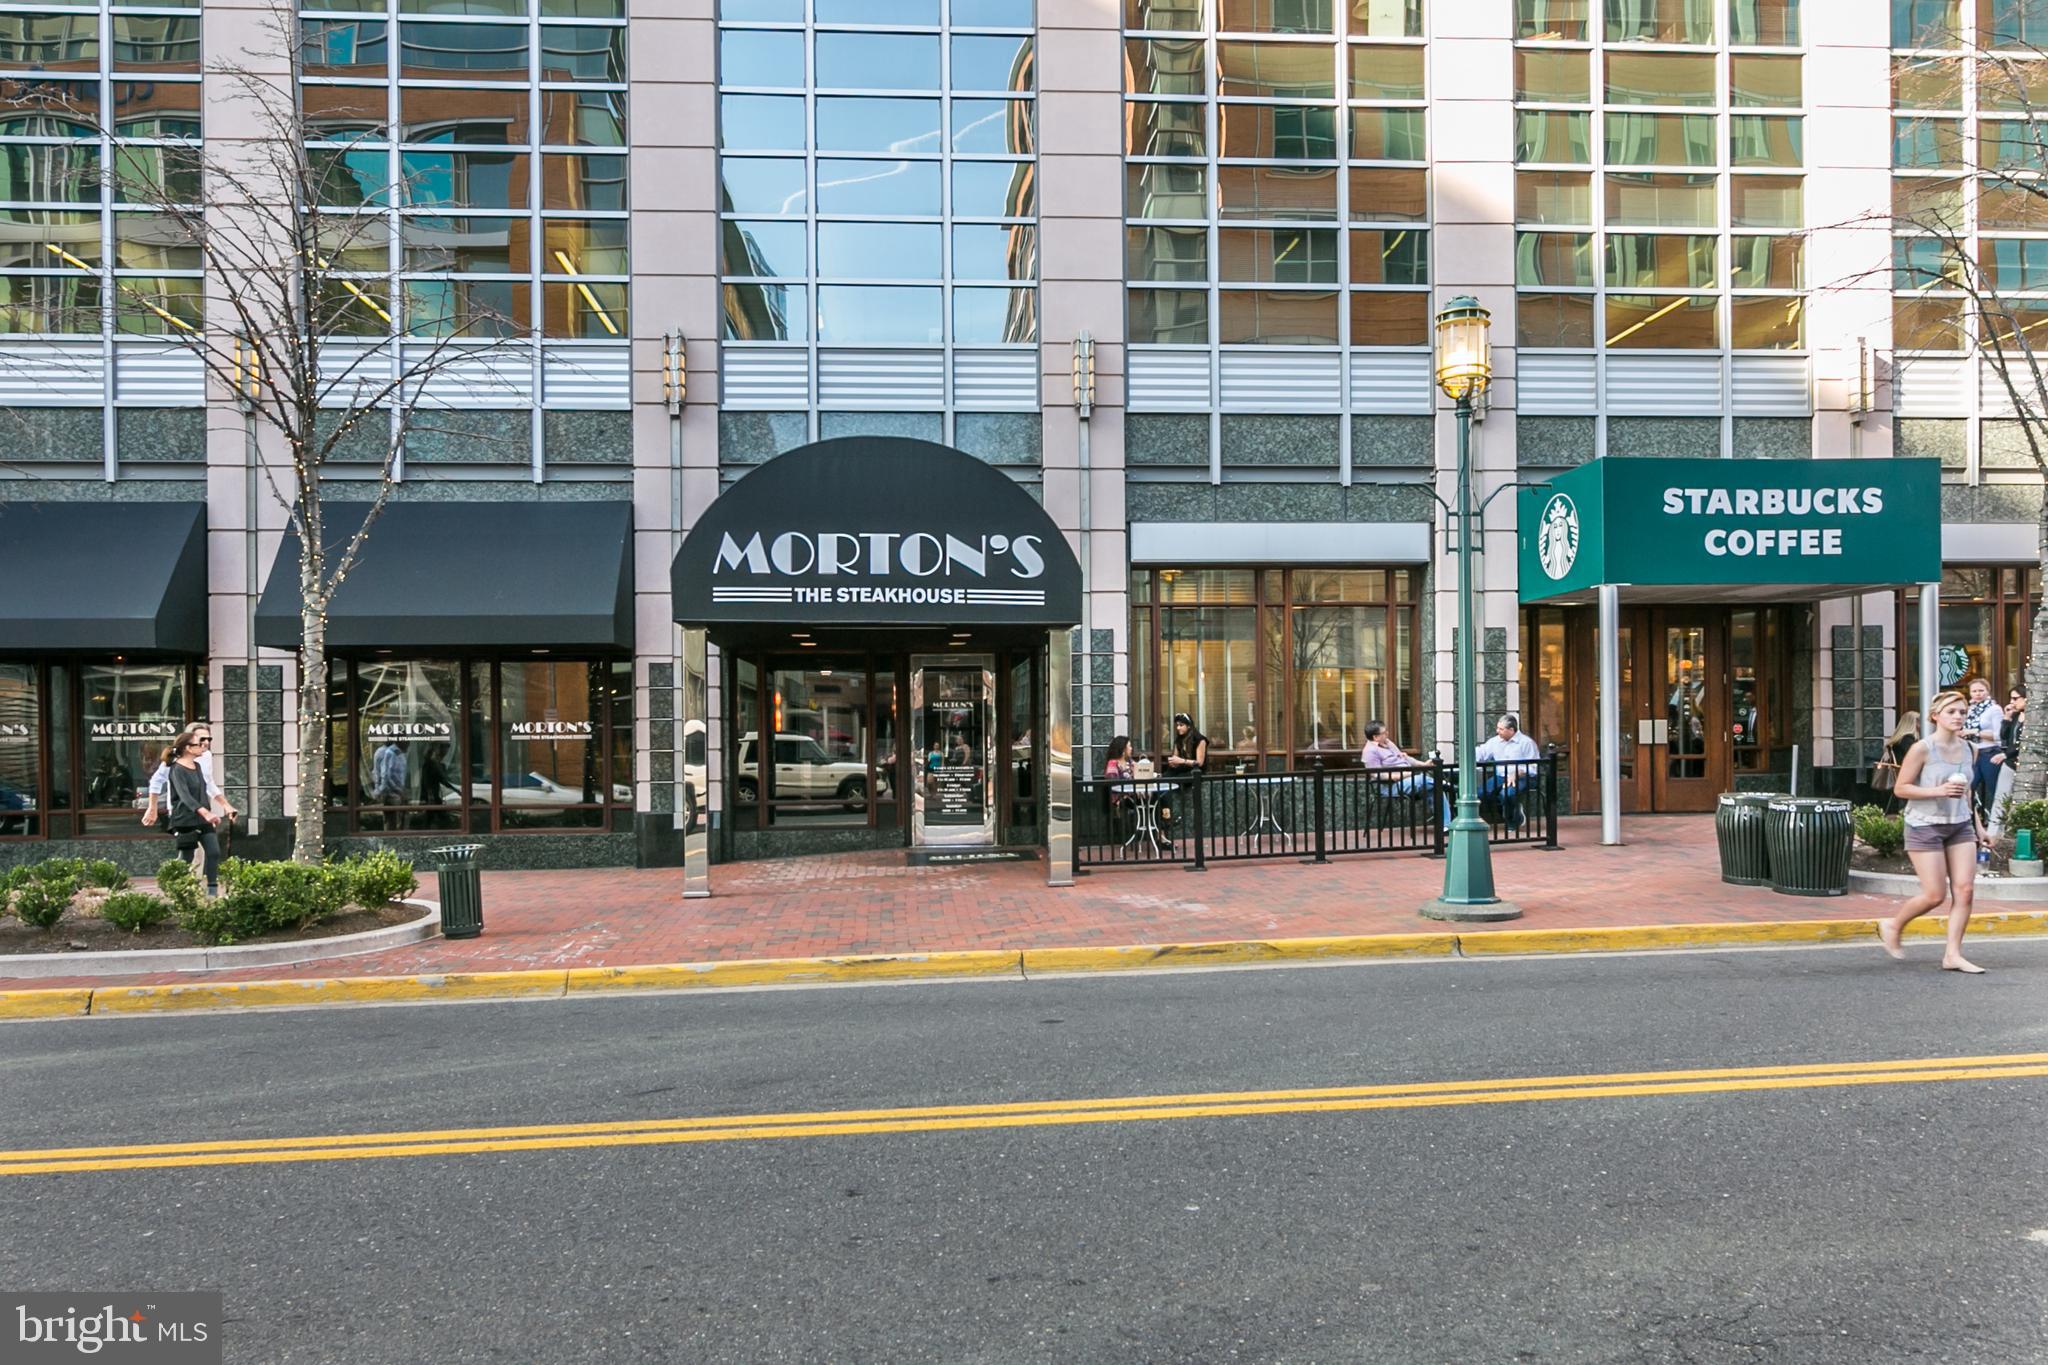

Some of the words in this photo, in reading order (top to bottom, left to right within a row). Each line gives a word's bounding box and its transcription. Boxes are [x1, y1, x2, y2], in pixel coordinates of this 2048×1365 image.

[1663, 487, 1883, 515] STARBUCKS
[1704, 528, 1842, 557] COFFEE
[712, 531, 1045, 578] MORTON'S
[794, 587, 832, 603] THE
[836, 587, 966, 605] STEAKHOUSE
[90, 722, 177, 735] MORTON'S
[367, 722, 451, 735] MORTON'S
[510, 721, 594, 734] MORTON'S
